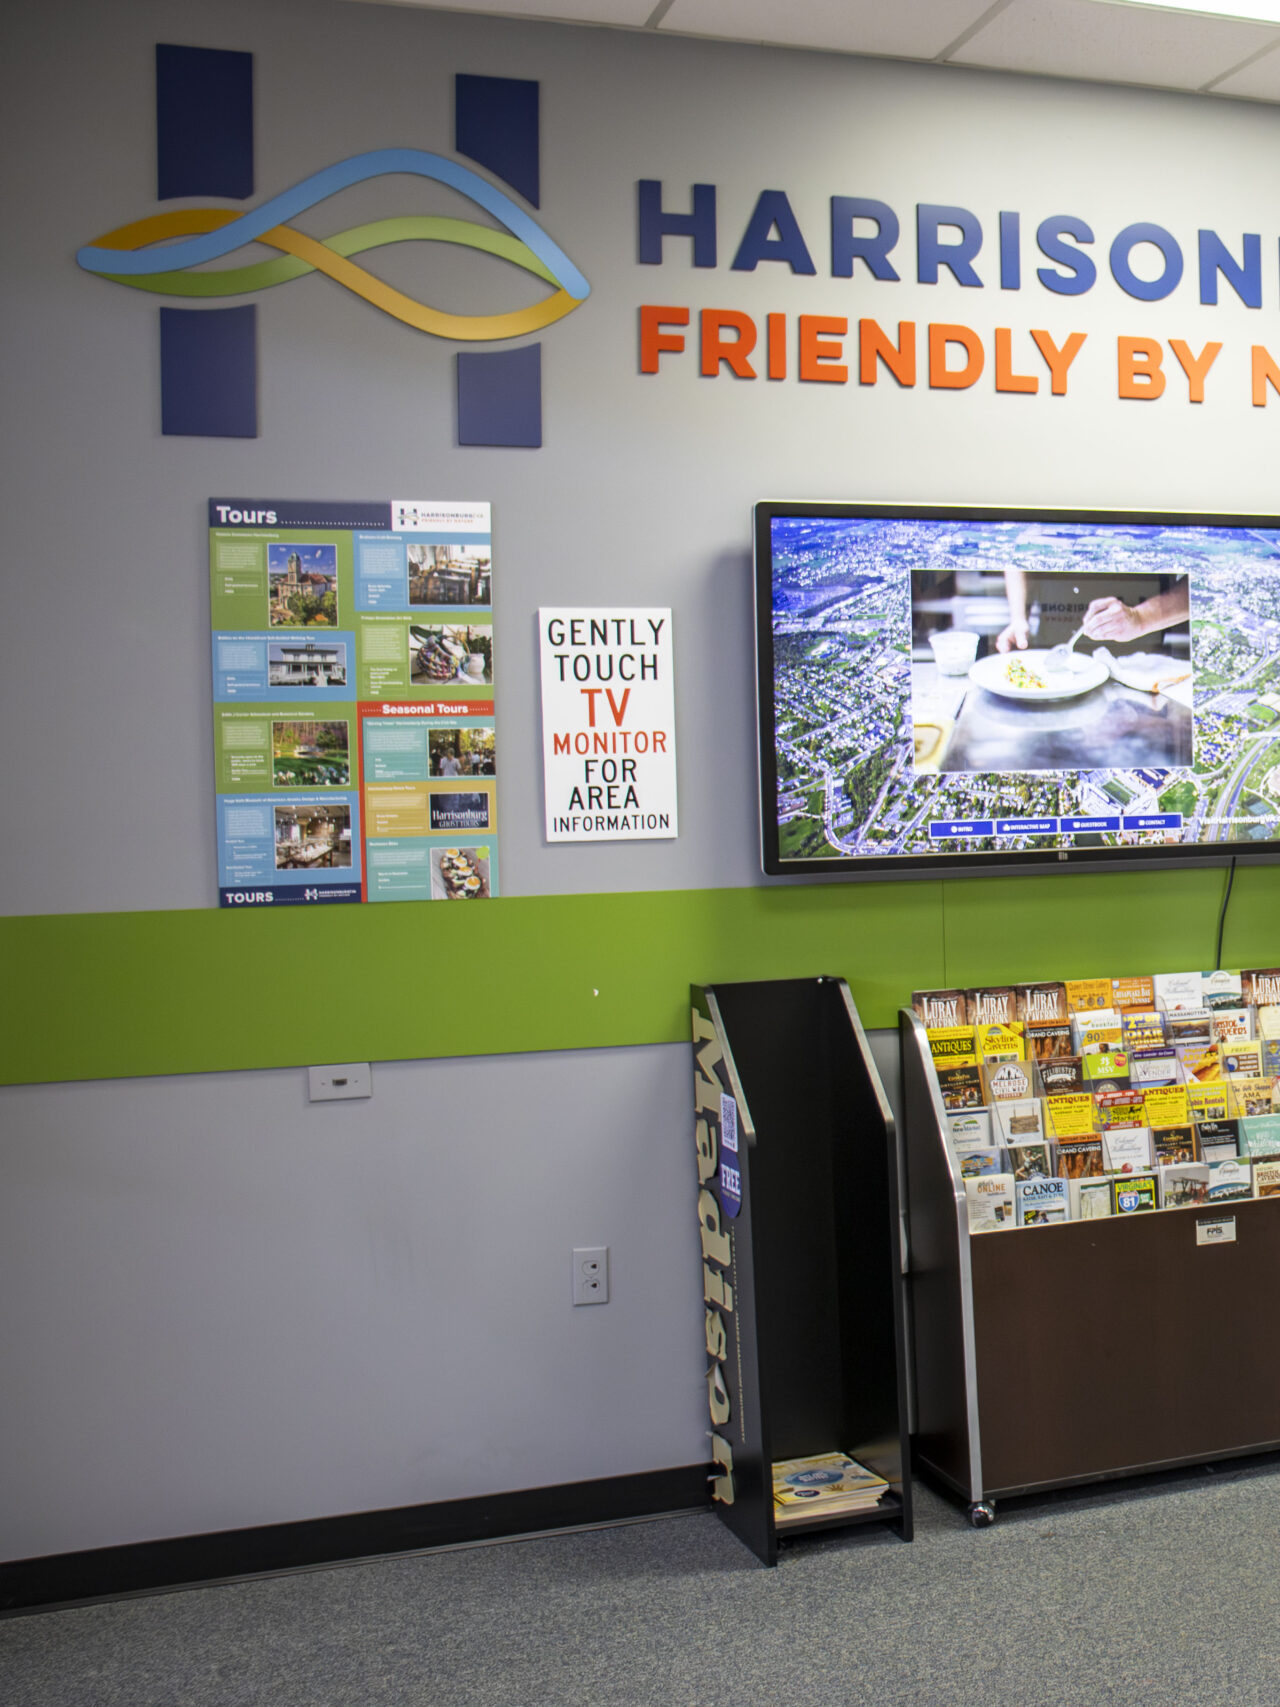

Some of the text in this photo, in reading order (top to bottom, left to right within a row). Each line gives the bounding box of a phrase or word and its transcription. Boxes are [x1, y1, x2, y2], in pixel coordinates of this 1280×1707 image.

[637, 304, 1088, 396] FRIENDLY
[1117, 335, 1223, 403] BY
[216, 506, 278, 525] Tours
[548, 618, 664, 646] GENTLY
[554, 654, 658, 682] TOUCH
[382, 703, 469, 714] Seasonal Tours
[580, 688, 631, 728] TV
[553, 730, 667, 755] MONITOR
[584, 758, 637, 784] FOR
[568, 785, 640, 811] AREA
[432, 809, 487, 821] Harrisonburg
[553, 813, 670, 833] INFORMATION
[225, 892, 274, 903] TOURS
[975, 992, 1008, 1014] LURAY
[1026, 990, 1059, 1011] LURAY
[922, 997, 957, 1020] LURAY
[931, 1040, 972, 1054] ANTIQUES
[983, 1042, 1018, 1051] Caverns
[984, 1034, 1016, 1046] Skyline
[1042, 1066, 1076, 1080] FILIBUSTER
[992, 1079, 1026, 1088] MELROSE
[1144, 1086, 1184, 1096] ANTIQUES
[1048, 1096, 1090, 1104] ANTIQUES
[1077, 1145, 1102, 1153] CAVERNS
[720, 1162, 741, 1196] FREE
[978, 1183, 1006, 1194] ONLINE
[1022, 1182, 1064, 1196] CANOE
[1117, 1182, 1153, 1192] VIRGINIA'S
[1122, 1196, 1136, 1208] 81
[691, 1006, 737, 1506] Madison
